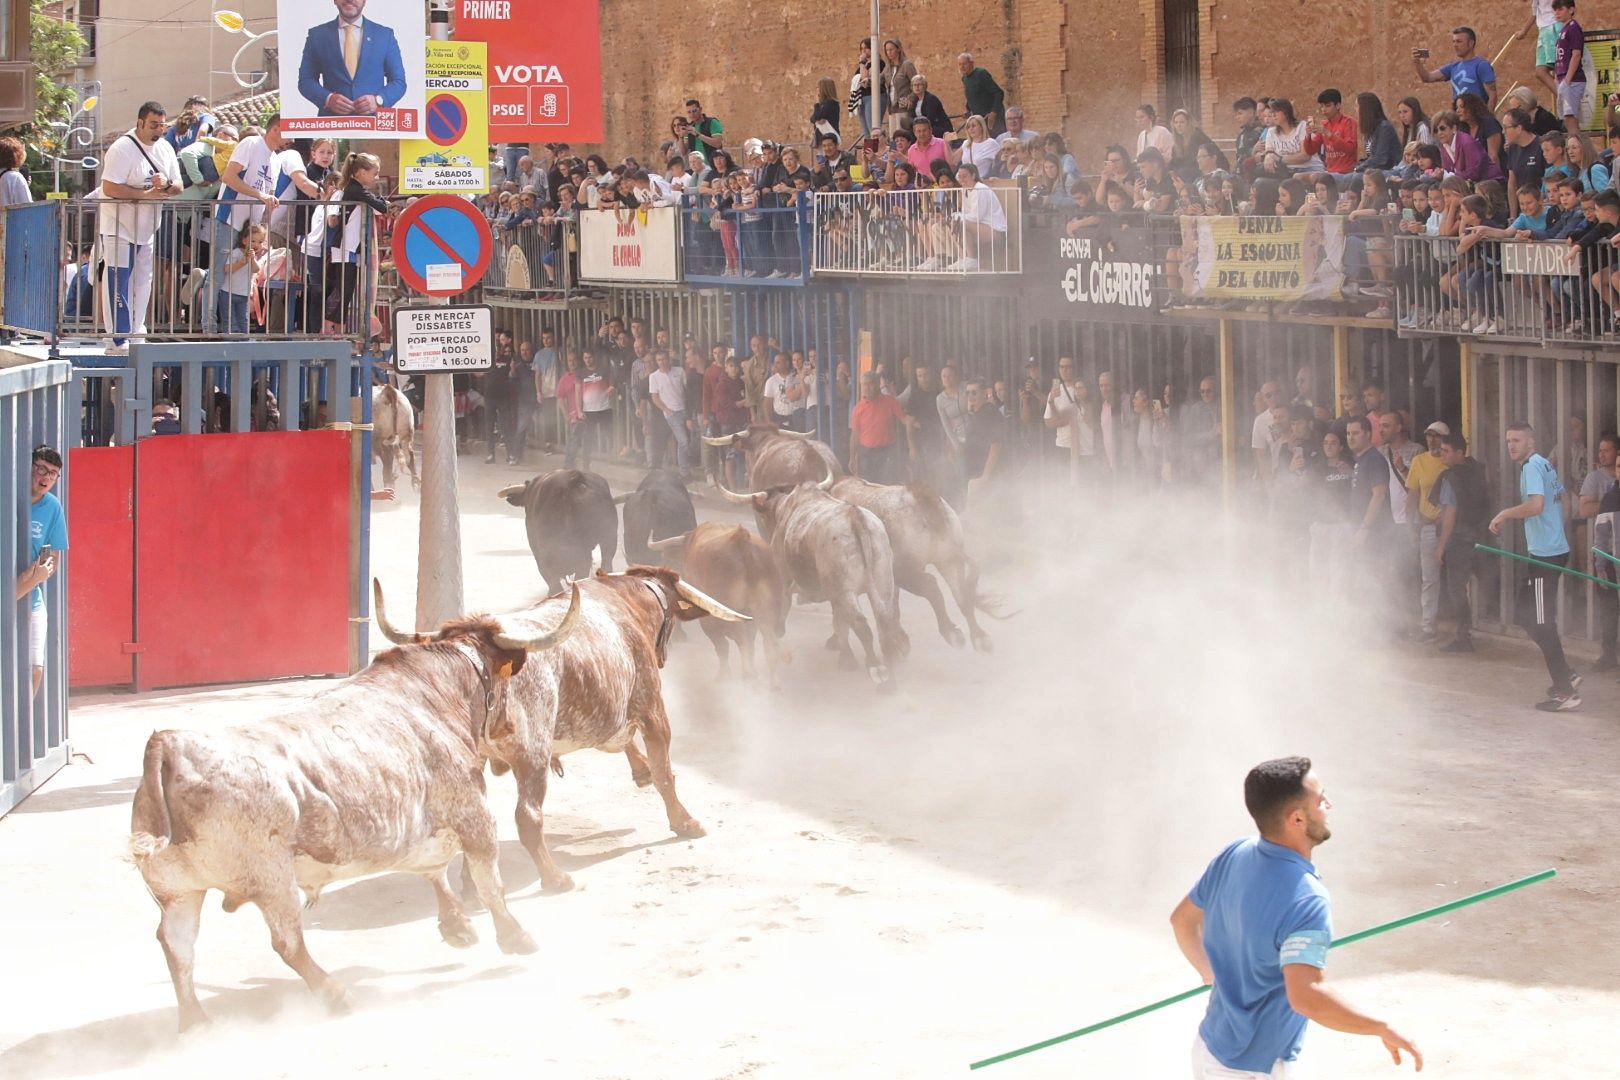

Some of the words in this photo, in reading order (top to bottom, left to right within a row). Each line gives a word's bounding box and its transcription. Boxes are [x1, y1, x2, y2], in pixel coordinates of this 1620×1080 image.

[463, 1, 511, 19] PRIMER
[494, 65, 564, 83] VOTA
[492, 104, 525, 116] PSOE
[377, 111, 395, 119] PSPV
[288, 120, 371, 129] #AlcaldeBenlloch
[377, 119, 395, 128] PSOE
[434, 170, 472, 178] SÁBADOS
[1237, 216, 1283, 234] PENYA
[1216, 243, 1233, 261] LA
[1239, 243, 1301, 264] ESQUINA
[1217, 270, 1248, 288] DEL
[1253, 264, 1300, 288] CANTÓ
[411, 313, 431, 321] PER
[434, 312, 475, 320] MERCAT
[416, 321, 472, 330] DISSABTES
[431, 335, 481, 344] MERCADO
[441, 346, 468, 354] ADOS
[451, 357, 476, 366] 16:00
